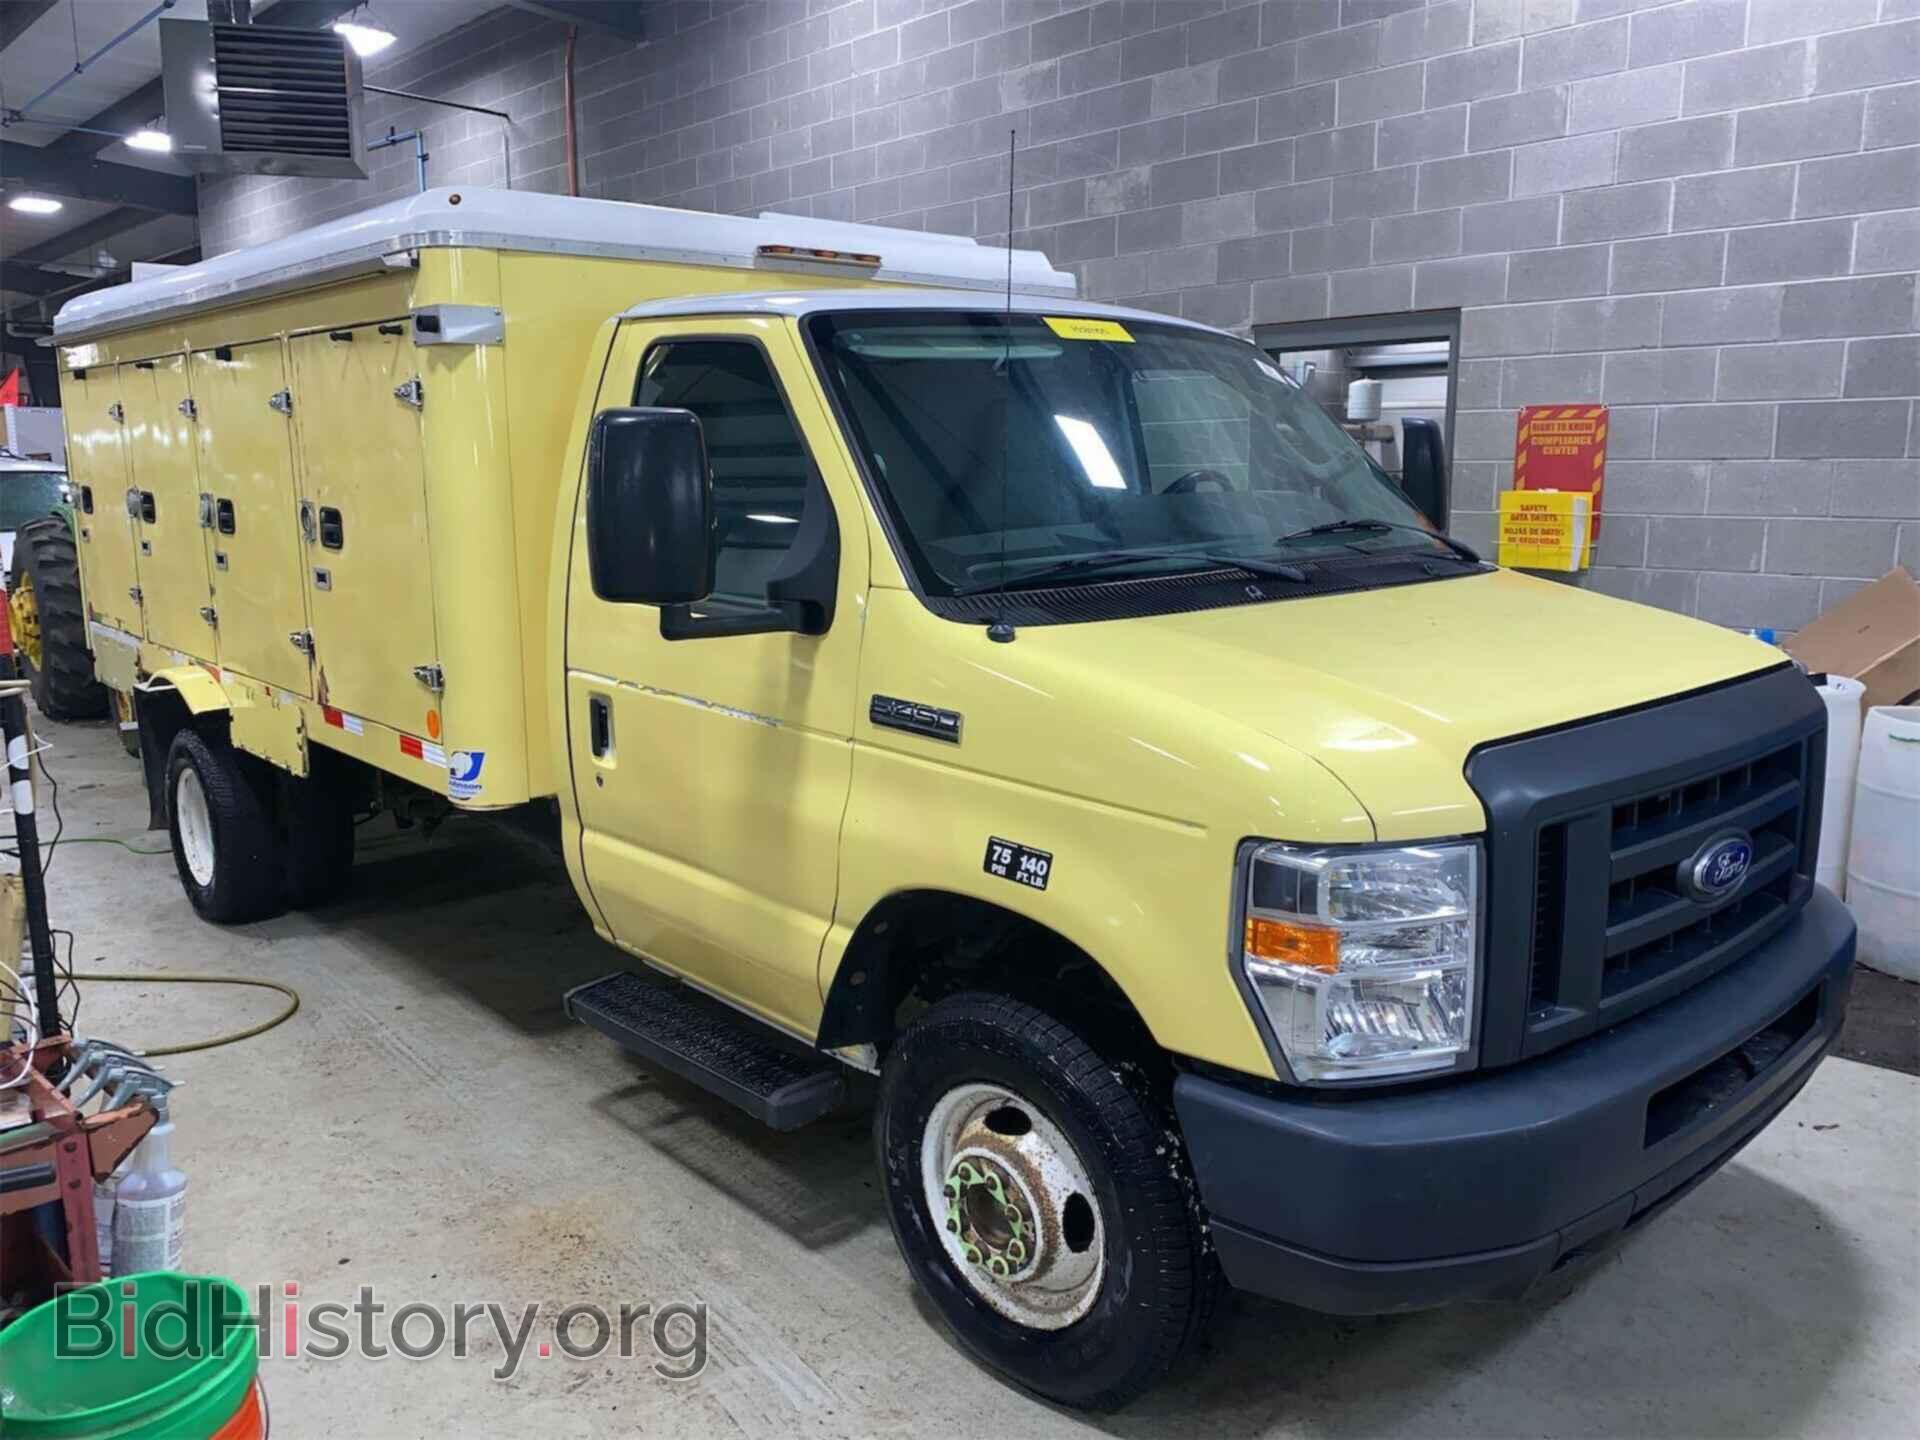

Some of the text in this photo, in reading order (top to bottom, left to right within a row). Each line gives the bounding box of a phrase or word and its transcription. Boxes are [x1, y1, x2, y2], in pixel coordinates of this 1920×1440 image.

[1519, 504, 1548, 512] SAFETY
[992, 845, 1012, 865] 75
[991, 863, 1007, 876] PSI
[1020, 855, 1048, 877] 140
[1713, 851, 1746, 885] Ford
